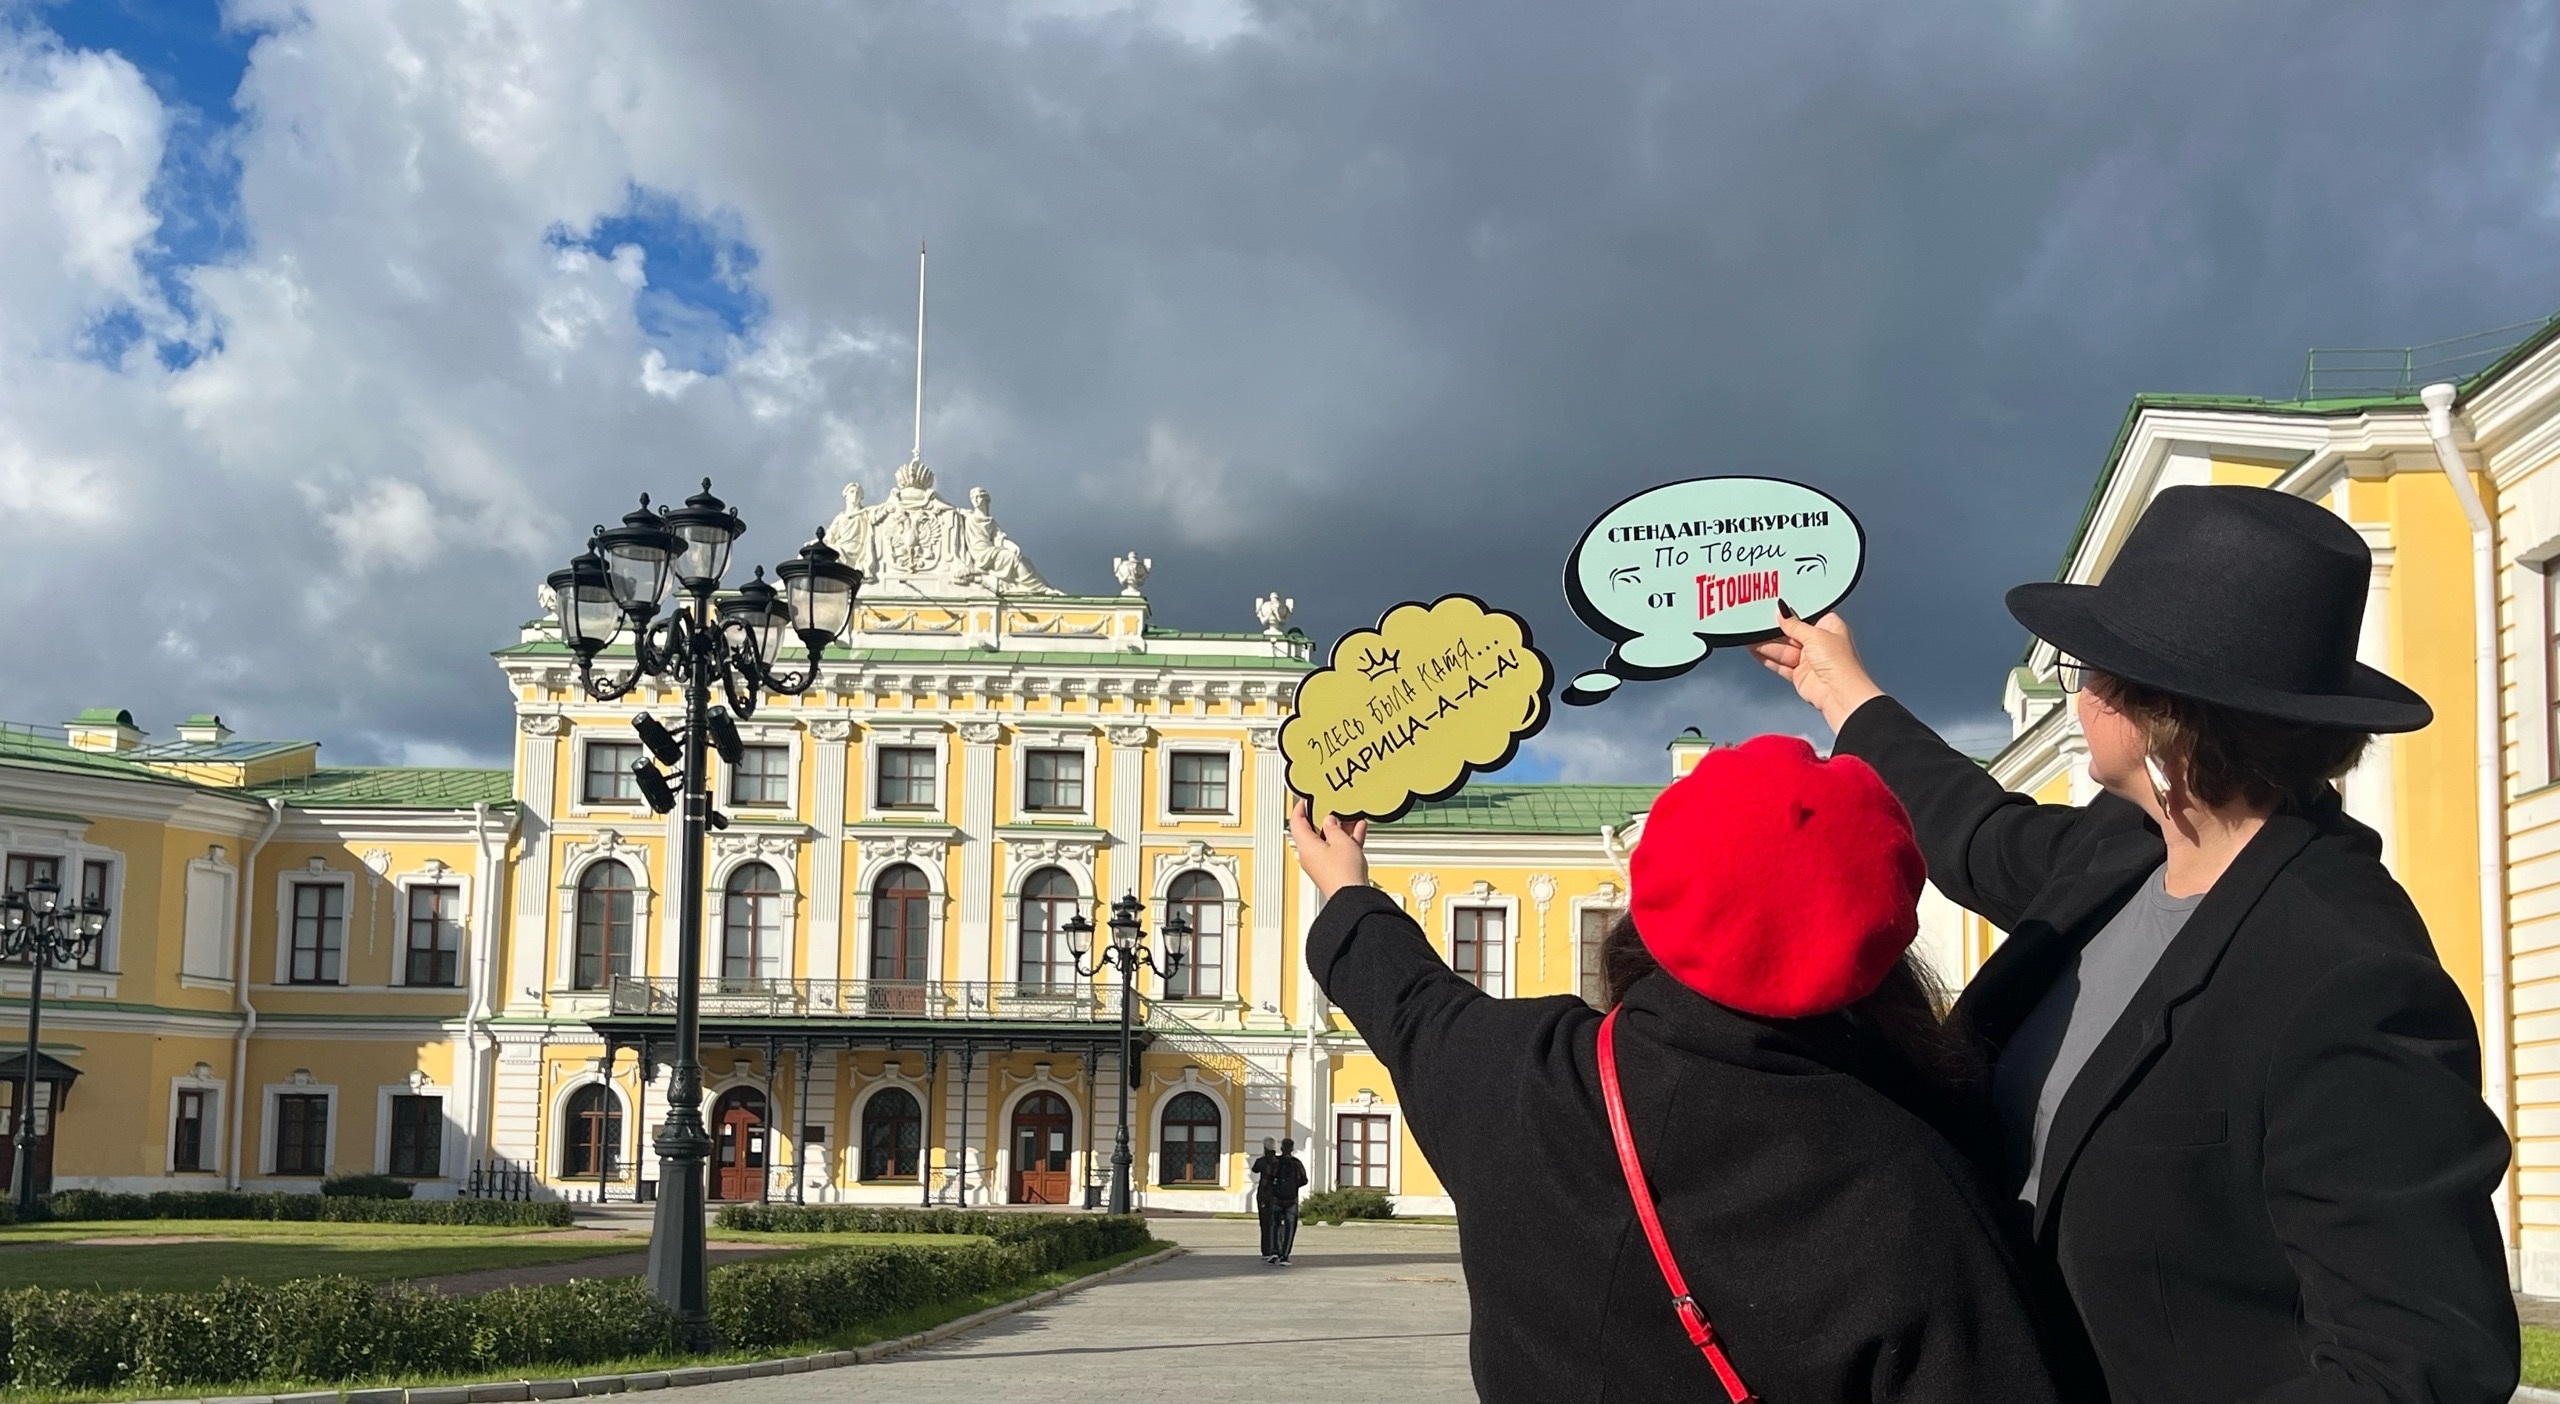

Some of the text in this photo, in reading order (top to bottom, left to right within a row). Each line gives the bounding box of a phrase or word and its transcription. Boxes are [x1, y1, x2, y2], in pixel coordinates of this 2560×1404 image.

[1608, 511, 1829, 543] СТЕНДАП-ЭКСКУРСИЯ
[1655, 541, 1787, 568] По Твери
[1696, 570, 1779, 620] ТЁТОШНАЯ
[1307, 717, 1365, 765] ЗДЕСЬ
[1366, 678, 1416, 724] БЫЛА
[1325, 648, 1519, 792] ЦАРИЦА-А-А-А!
